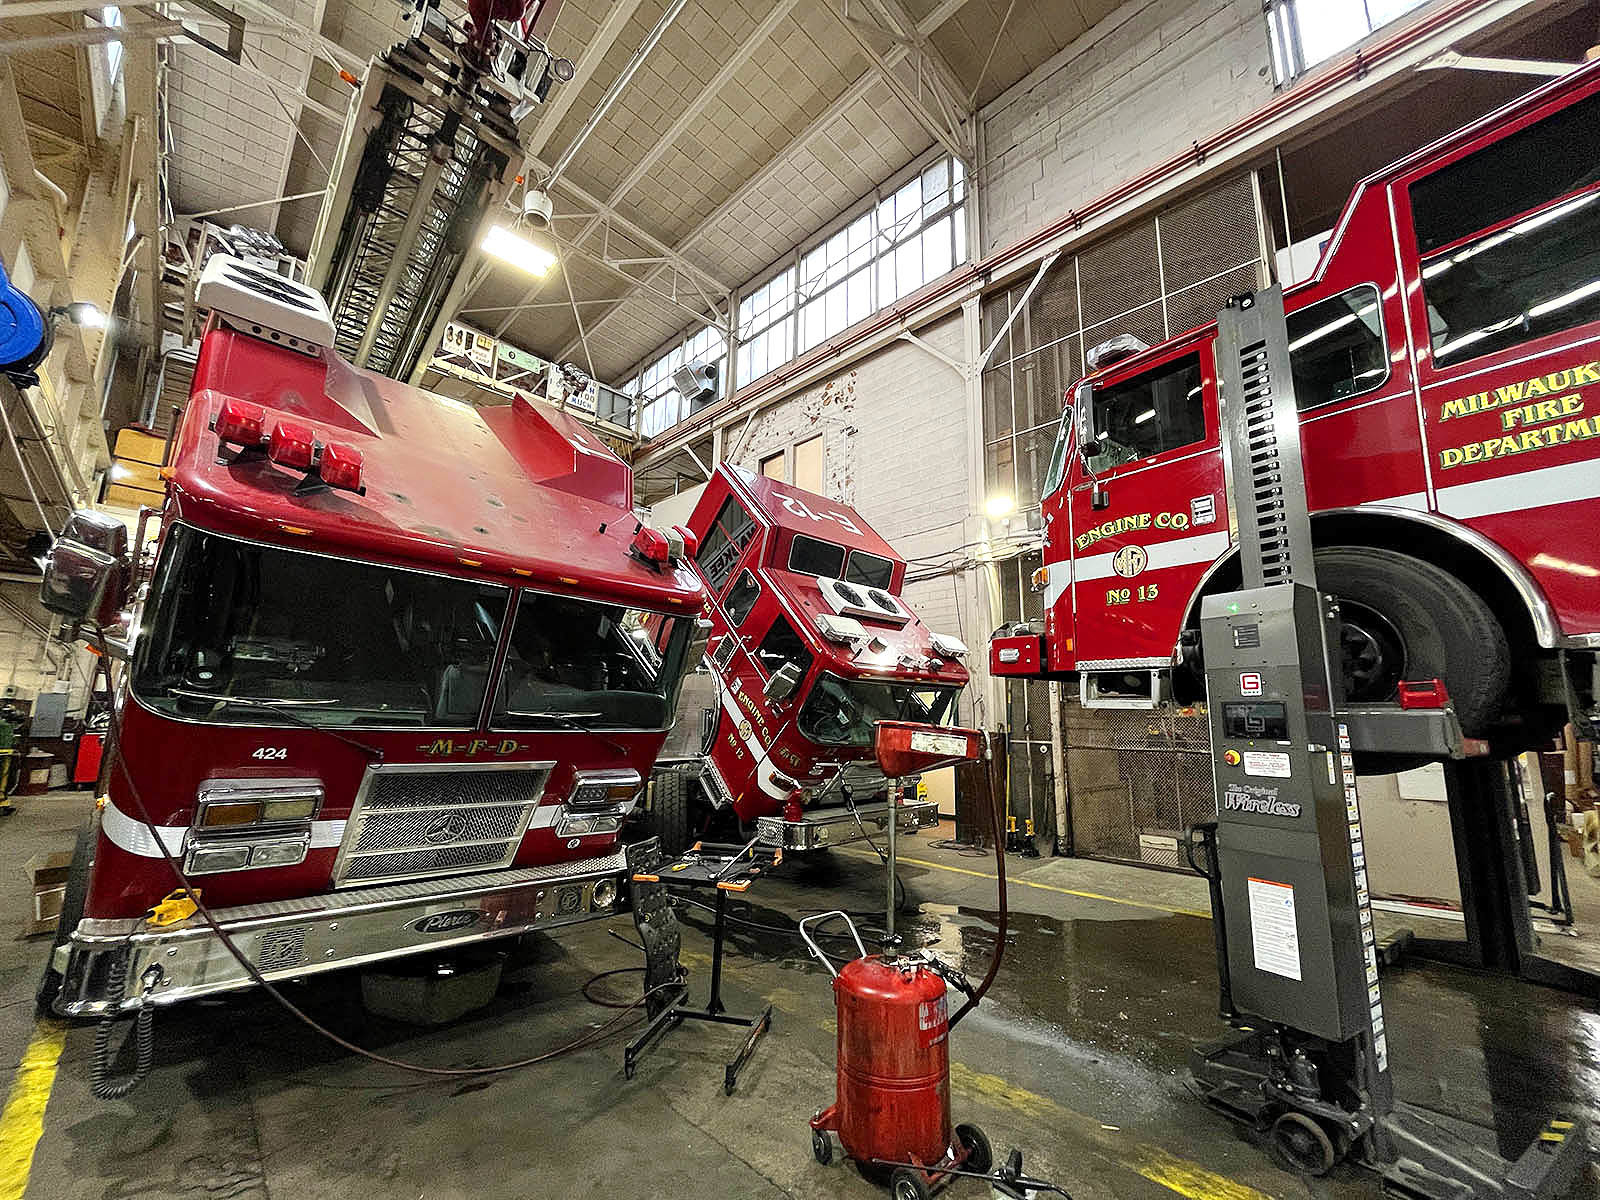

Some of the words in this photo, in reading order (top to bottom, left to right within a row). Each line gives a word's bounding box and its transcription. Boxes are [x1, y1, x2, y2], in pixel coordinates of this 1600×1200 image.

[1502, 393, 1585, 431] FIRE
[1077, 513, 1151, 551] ENGINE
[1155, 511, 1190, 531] CO.
[1137, 584, 1159, 602] 13
[738, 690, 765, 726] ENGINE
[252, 747, 287, 760] 424
[736, 747, 745, 760] 12
[1243, 785, 1279, 797] Original
[1224, 791, 1301, 817] Wireless
